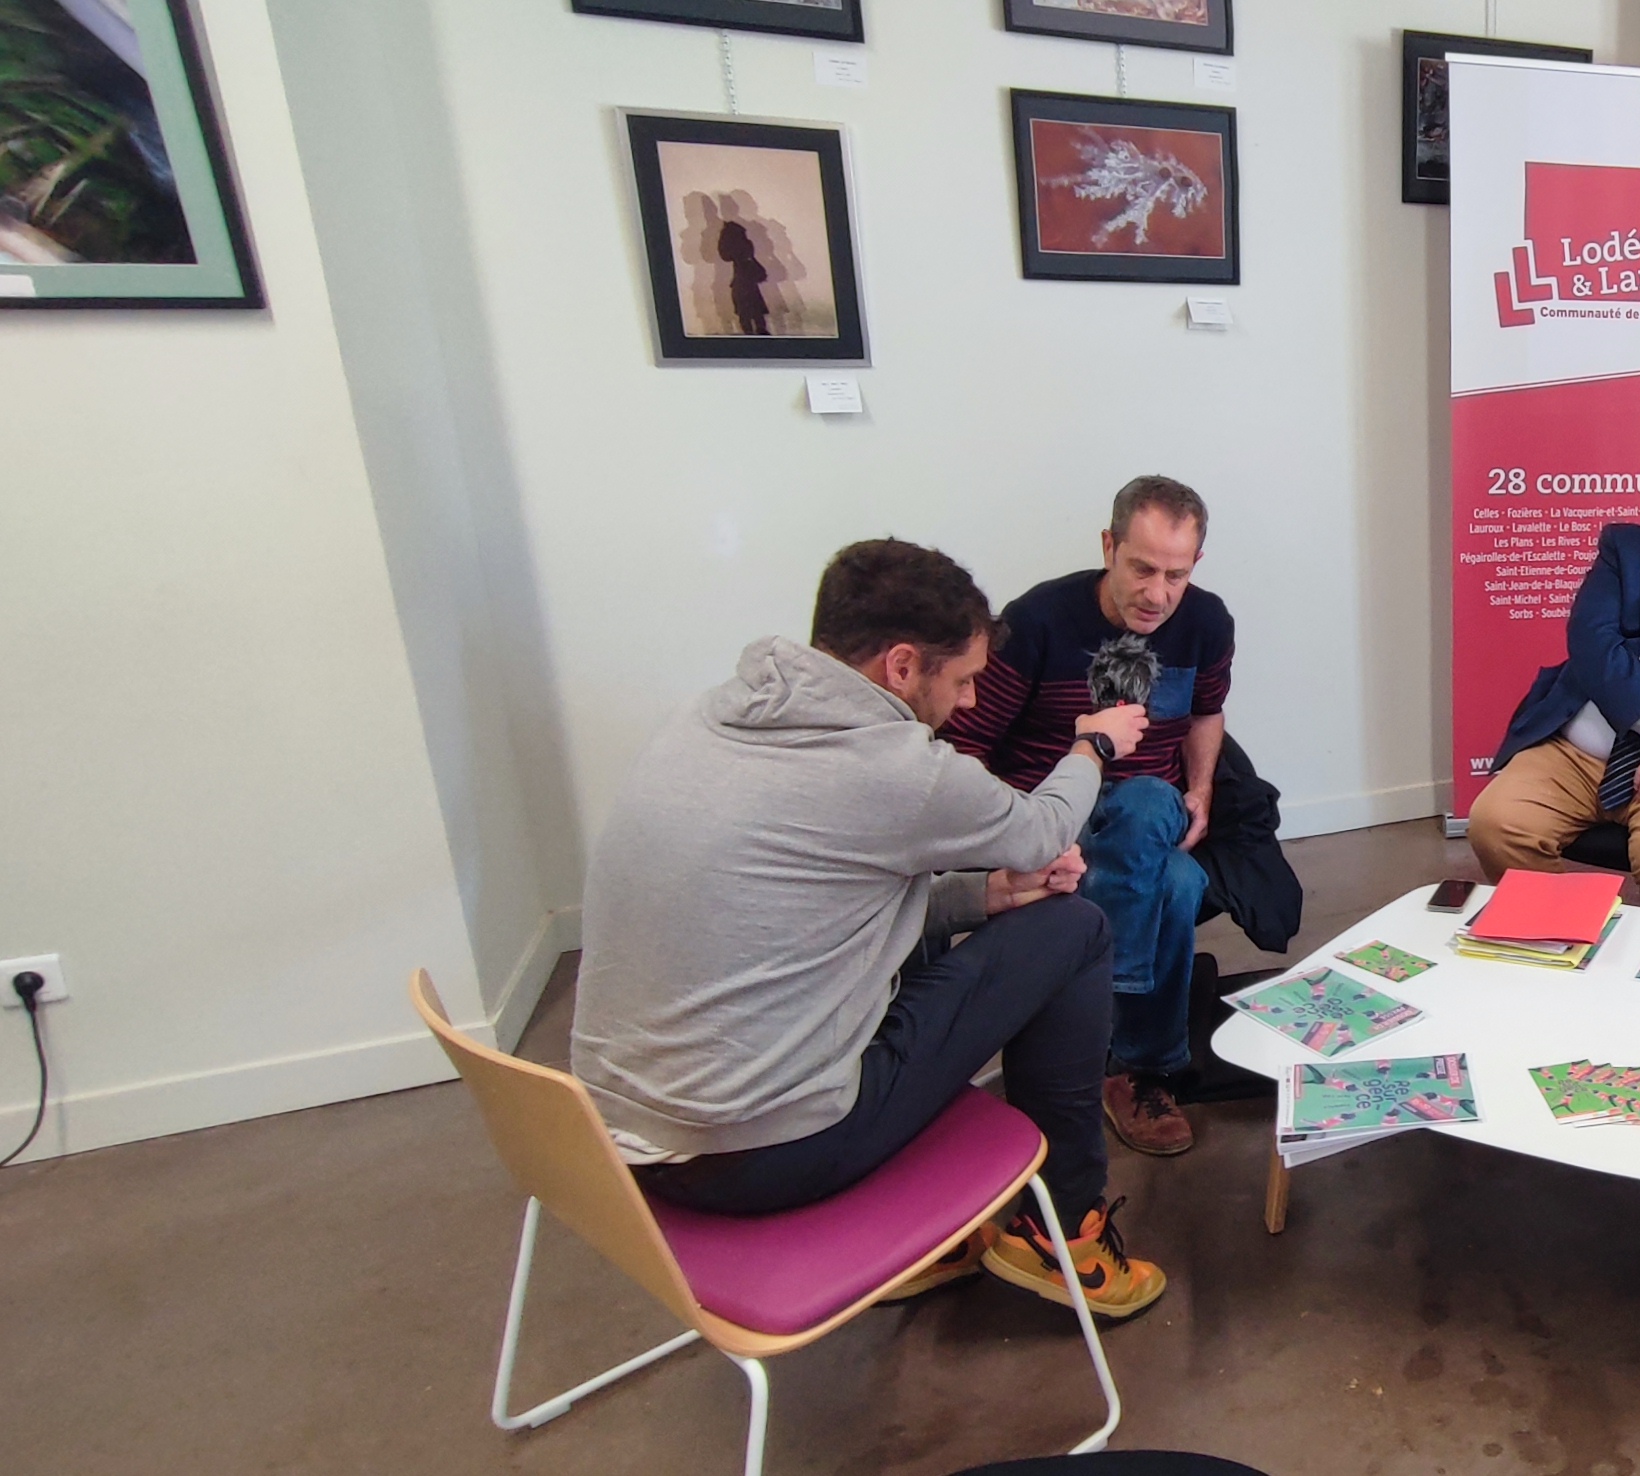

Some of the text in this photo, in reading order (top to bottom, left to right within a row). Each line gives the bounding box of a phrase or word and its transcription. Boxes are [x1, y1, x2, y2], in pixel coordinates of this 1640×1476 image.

[1572, 275, 1592, 296] &
[1540, 306, 1621, 320] Communauté
[1625, 308, 1640, 320] de
[1488, 468, 1527, 495] 28
[1473, 508, 1499, 519] Celles
[1507, 507, 1543, 518] Fozières
[1550, 507, 1561, 518] La
[1469, 523, 1504, 534] Lauroux
[1512, 522, 1551, 533] Lavalette
[1559, 521, 1569, 532] Le
[1571, 521, 1591, 532] Bosc
[1494, 537, 1509, 548] Les
[1511, 537, 1534, 548] Plans
[1541, 536, 1556, 547] Les
[1558, 536, 1581, 547] Rives
[1489, 594, 1541, 606] Saint-Michel
[1509, 607, 1571, 619] Sorbs Soubès
[1356, 1094, 1371, 1109] ce
